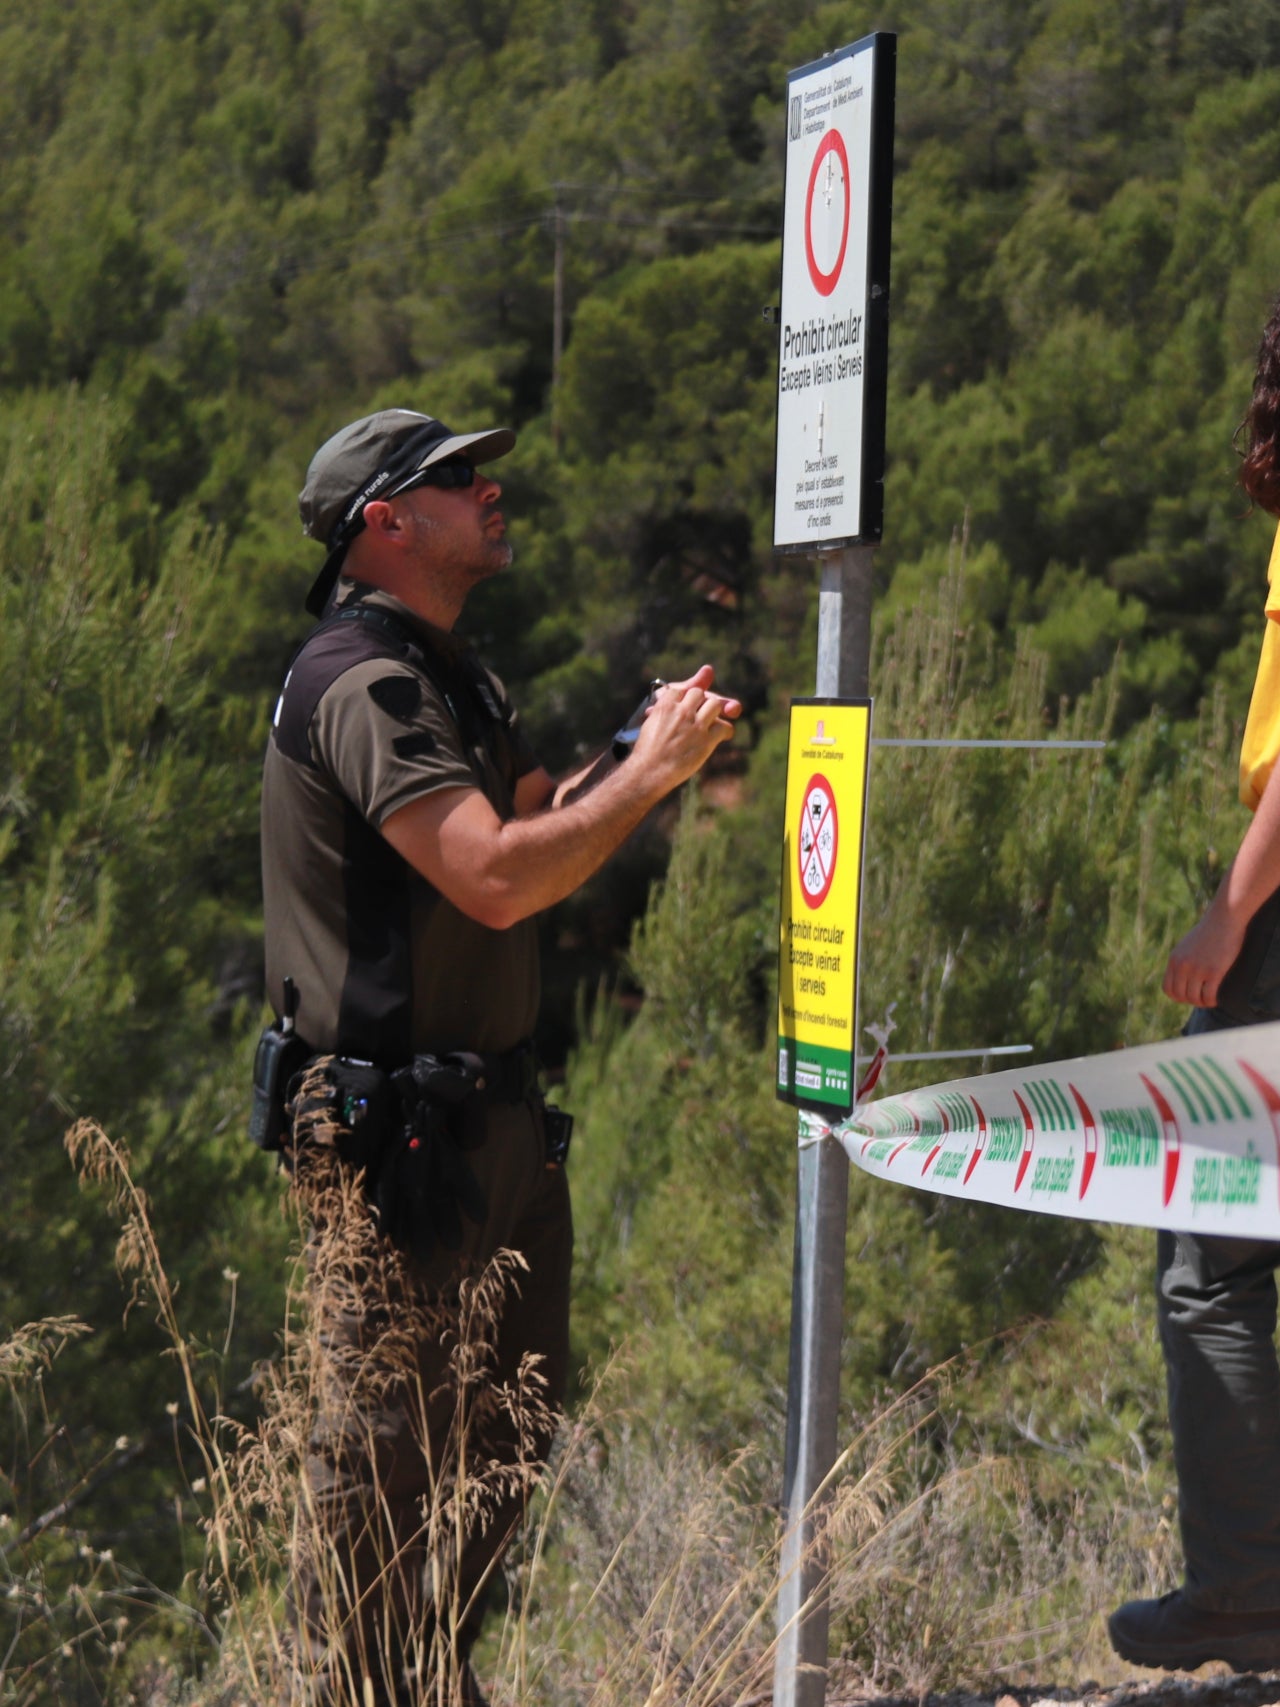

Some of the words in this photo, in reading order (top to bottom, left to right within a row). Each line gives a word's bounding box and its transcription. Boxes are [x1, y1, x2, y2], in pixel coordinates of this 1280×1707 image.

[783, 317, 825, 360] Prohibit
[826, 308, 862, 351] circular
[781, 364, 811, 395] Excepte
[837, 349, 863, 380] Serveis
[364, 471, 390, 496] rurals
[787, 917, 812, 940] Prohibit
[812, 923, 845, 945] circular
[788, 943, 814, 970] Excepte
[799, 975, 826, 996] serveis
